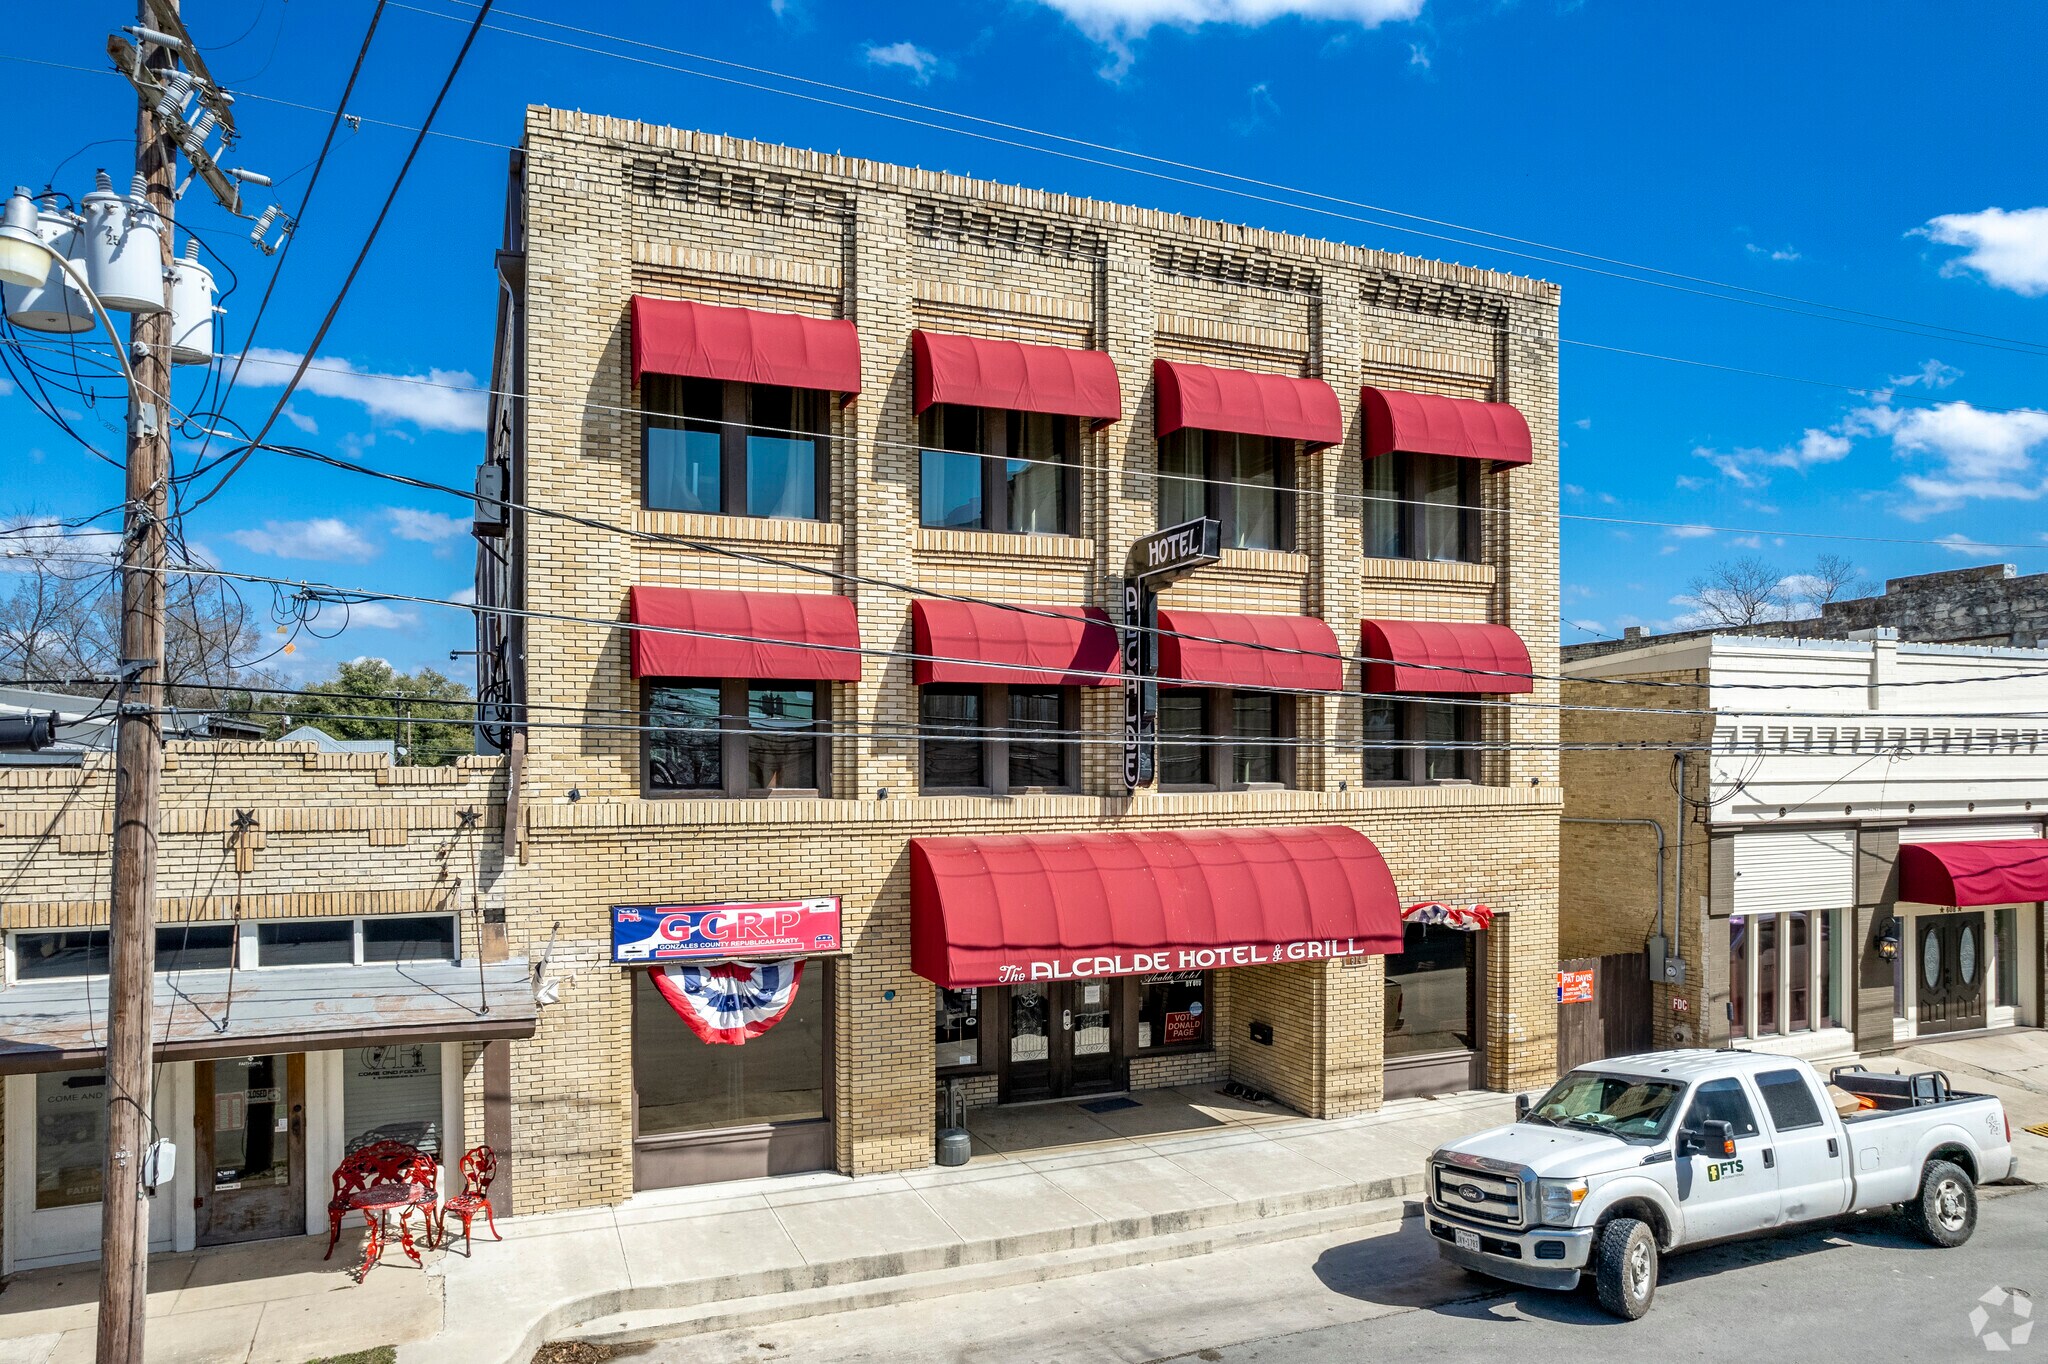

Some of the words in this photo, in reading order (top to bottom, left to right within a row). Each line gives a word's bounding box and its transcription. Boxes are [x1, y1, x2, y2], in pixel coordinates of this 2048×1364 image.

[106, 234, 121, 246] 25
[1148, 528, 1199, 567] HOTEL
[1125, 586, 1138, 782] ALCALDE
[660, 910, 801, 941] GCRP
[659, 942, 699, 950] GONZALES
[700, 940, 730, 949] COUNTY
[730, 938, 775, 947] REPUBLICAN
[776, 937, 799, 945] PARTY
[998, 964, 1026, 983] The
[1031, 951, 1171, 980] ALCALDE
[1178, 945, 1269, 969] HOTEL
[1272, 943, 1284, 962] &
[1287, 938, 1365, 960] GRILL
[1174, 969, 1202, 981] Hotel
[1564, 975, 1575, 983] PAT
[1575, 974, 1592, 982] DAVIS
[1673, 998, 1688, 1011] FDC
[1174, 1013, 1196, 1022] VOTE
[1168, 1021, 1200, 1030] DONALD
[1173, 1029, 1194, 1037] PAGE
[47, 1093, 79, 1103] COME
[81, 1091, 103, 1100] AND
[246, 1089, 268, 1099] CLOSED
[1719, 1159, 1744, 1176] FTS
[66, 1184, 100, 1196] FAITH
[1462, 1188, 1477, 1199] Ford
